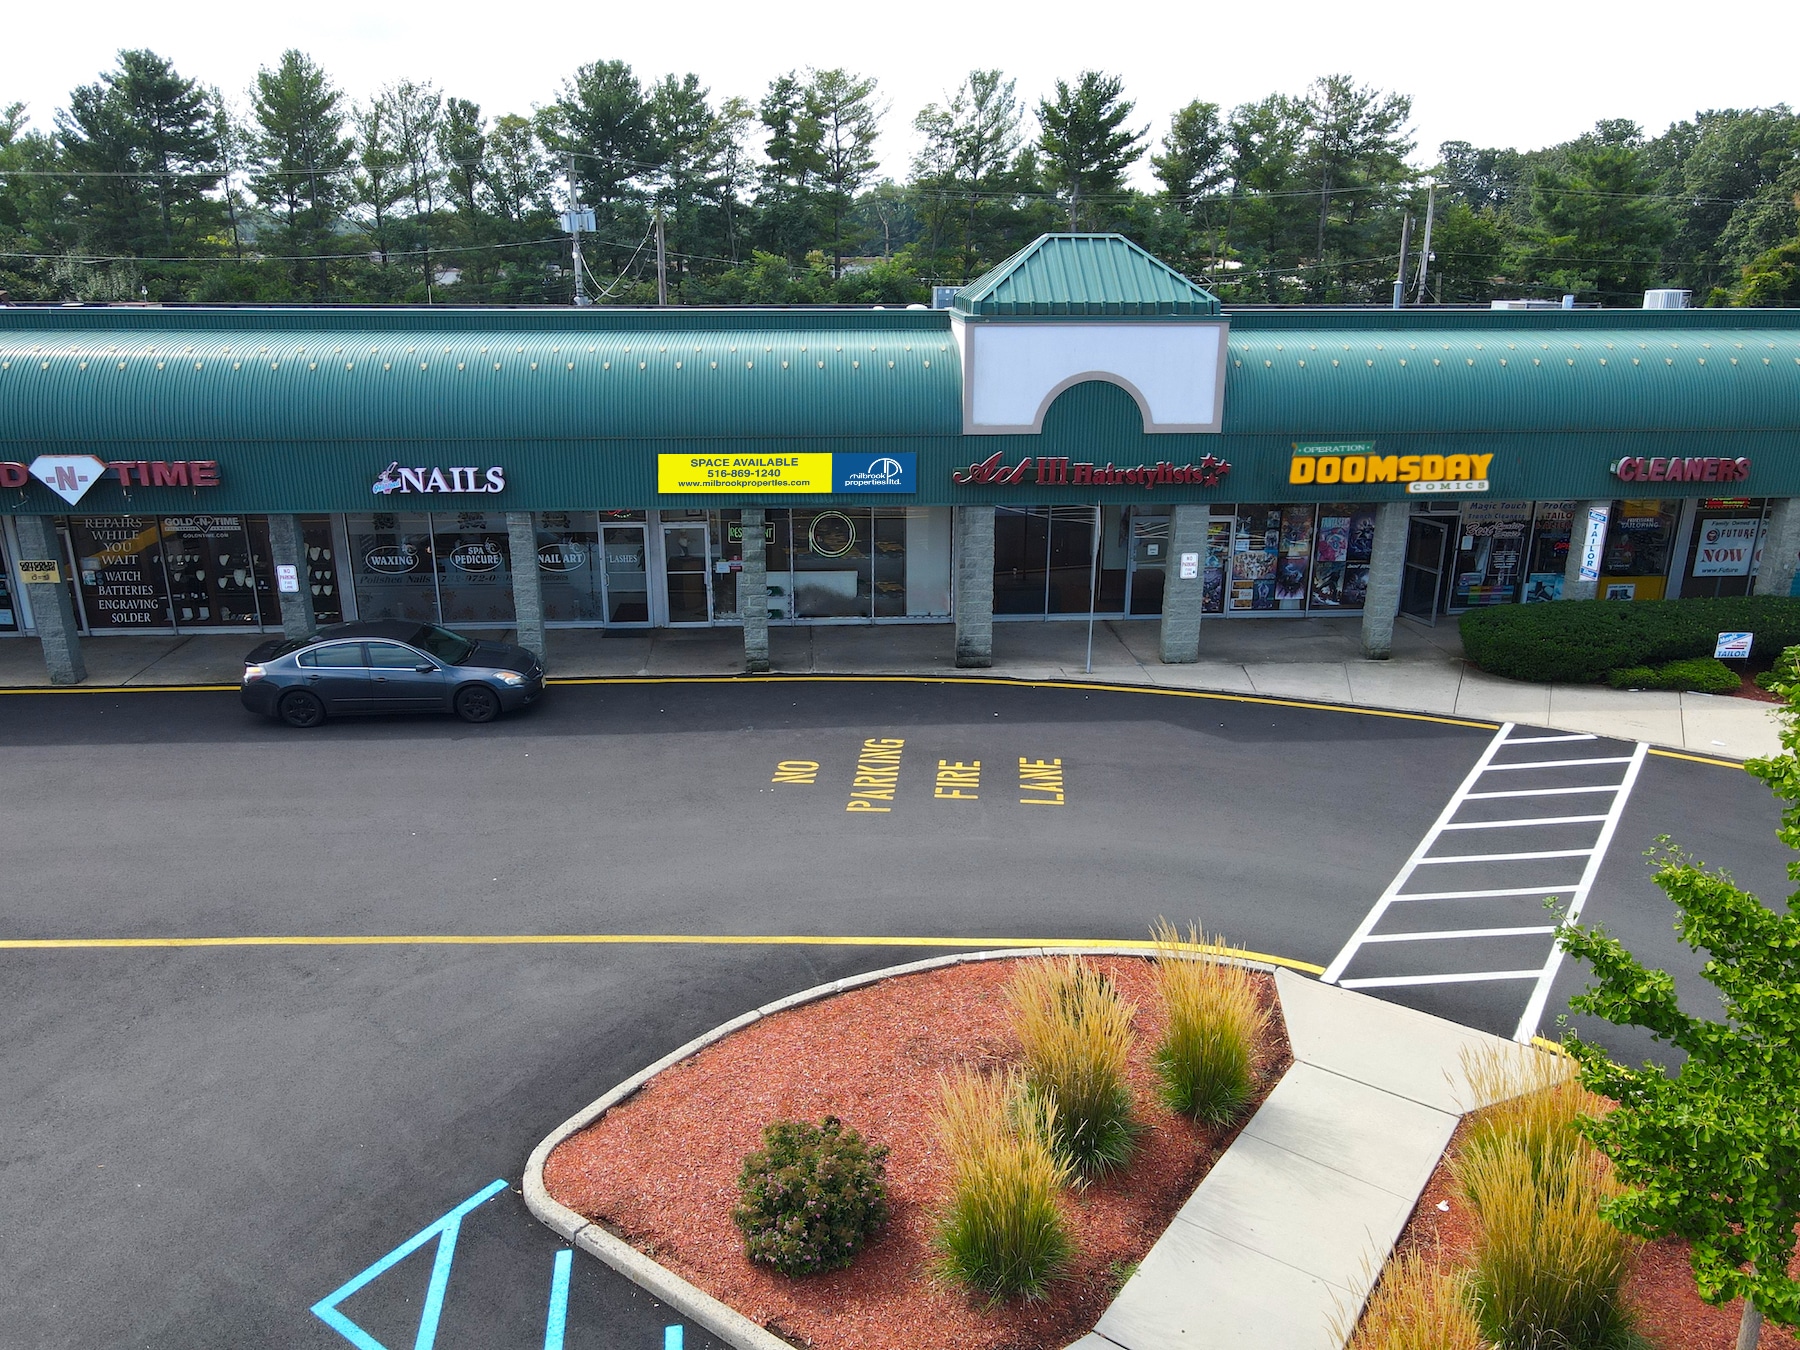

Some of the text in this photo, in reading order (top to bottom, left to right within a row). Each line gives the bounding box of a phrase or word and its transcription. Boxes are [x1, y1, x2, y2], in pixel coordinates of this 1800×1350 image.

[1303, 444, 1366, 453] OPERATION
[690, 457, 799, 467] SPACE AVAILABLE
[109, 460, 220, 487] TIME
[707, 469, 781, 478] 516-869-1240
[953, 450, 1204, 489] Act III Hairstylists
[1289, 453, 1494, 484] DOOMSDAY
[1617, 456, 1751, 482] CLEANERS
[397, 466, 506, 493] NAILS
[678, 479, 810, 488] www.milbrookproperties.com
[1413, 482, 1486, 491] COMICS
[1469, 502, 1497, 510] Magic
[84, 518, 143, 528] REPAIRS
[164, 517, 193, 526] GOLD
[213, 517, 240, 526] TIME
[1620, 521, 1659, 529] TAILORING
[1465, 521, 1495, 537] Best
[1720, 528, 1755, 539] FUTURE
[91, 530, 140, 540] WHILE
[103, 542, 132, 552] YOU
[1586, 523, 1599, 567] TAILOR
[468, 546, 484, 555] SPA
[1700, 548, 1748, 563] NOW
[101, 554, 139, 565] WAIT
[370, 556, 414, 566] WAXING
[454, 554, 499, 565] PEDICURE
[538, 554, 583, 563] NAIL ART
[609, 555, 638, 563] LASHES
[105, 571, 141, 581] WATCH
[406, 575, 431, 583] Nails
[98, 585, 154, 595] BATTERIES
[98, 599, 159, 610] ENGRAVING
[111, 612, 152, 623] SOLDER
[771, 738, 1065, 812] NO PARKING FIRE LANE
